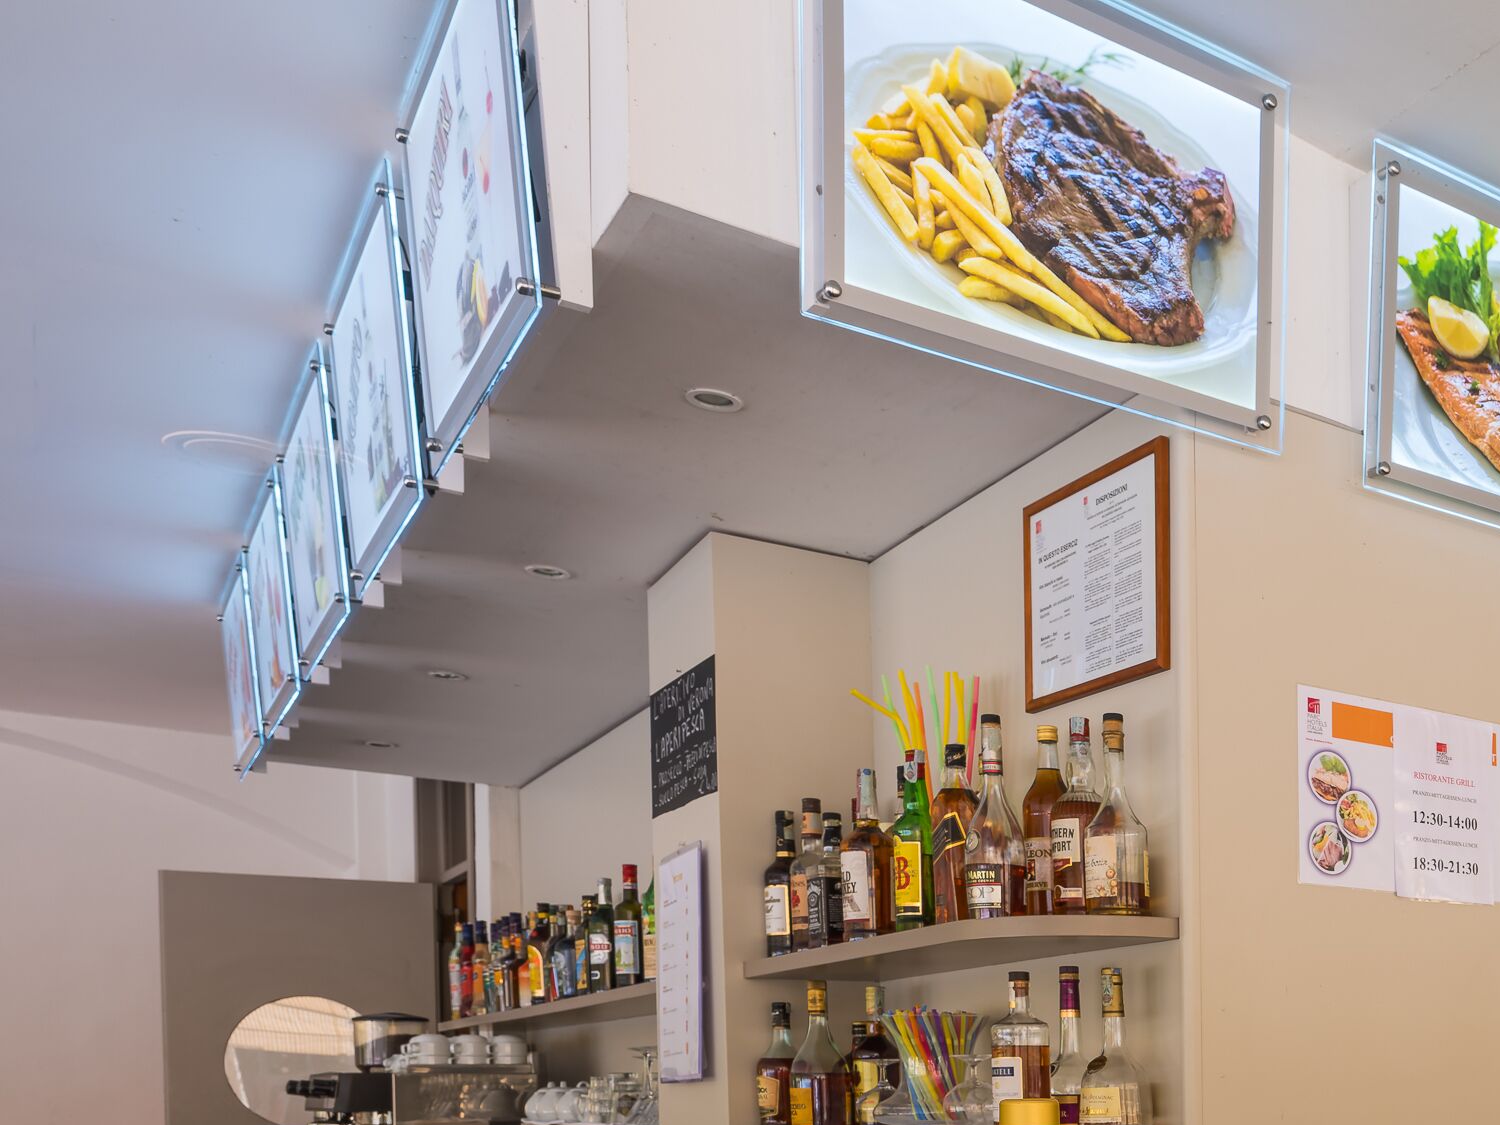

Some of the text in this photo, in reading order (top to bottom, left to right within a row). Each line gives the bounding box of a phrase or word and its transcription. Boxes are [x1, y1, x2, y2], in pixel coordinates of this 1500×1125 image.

[1060, 538, 1078, 553] ESERCIZ
[1413, 771, 1476, 787] RISTORANTE GRILL
[1413, 810, 1478, 831] 12:30-14:00
[1026, 848, 1052, 858] LEON
[1413, 857, 1479, 876] 18:30-21:30
